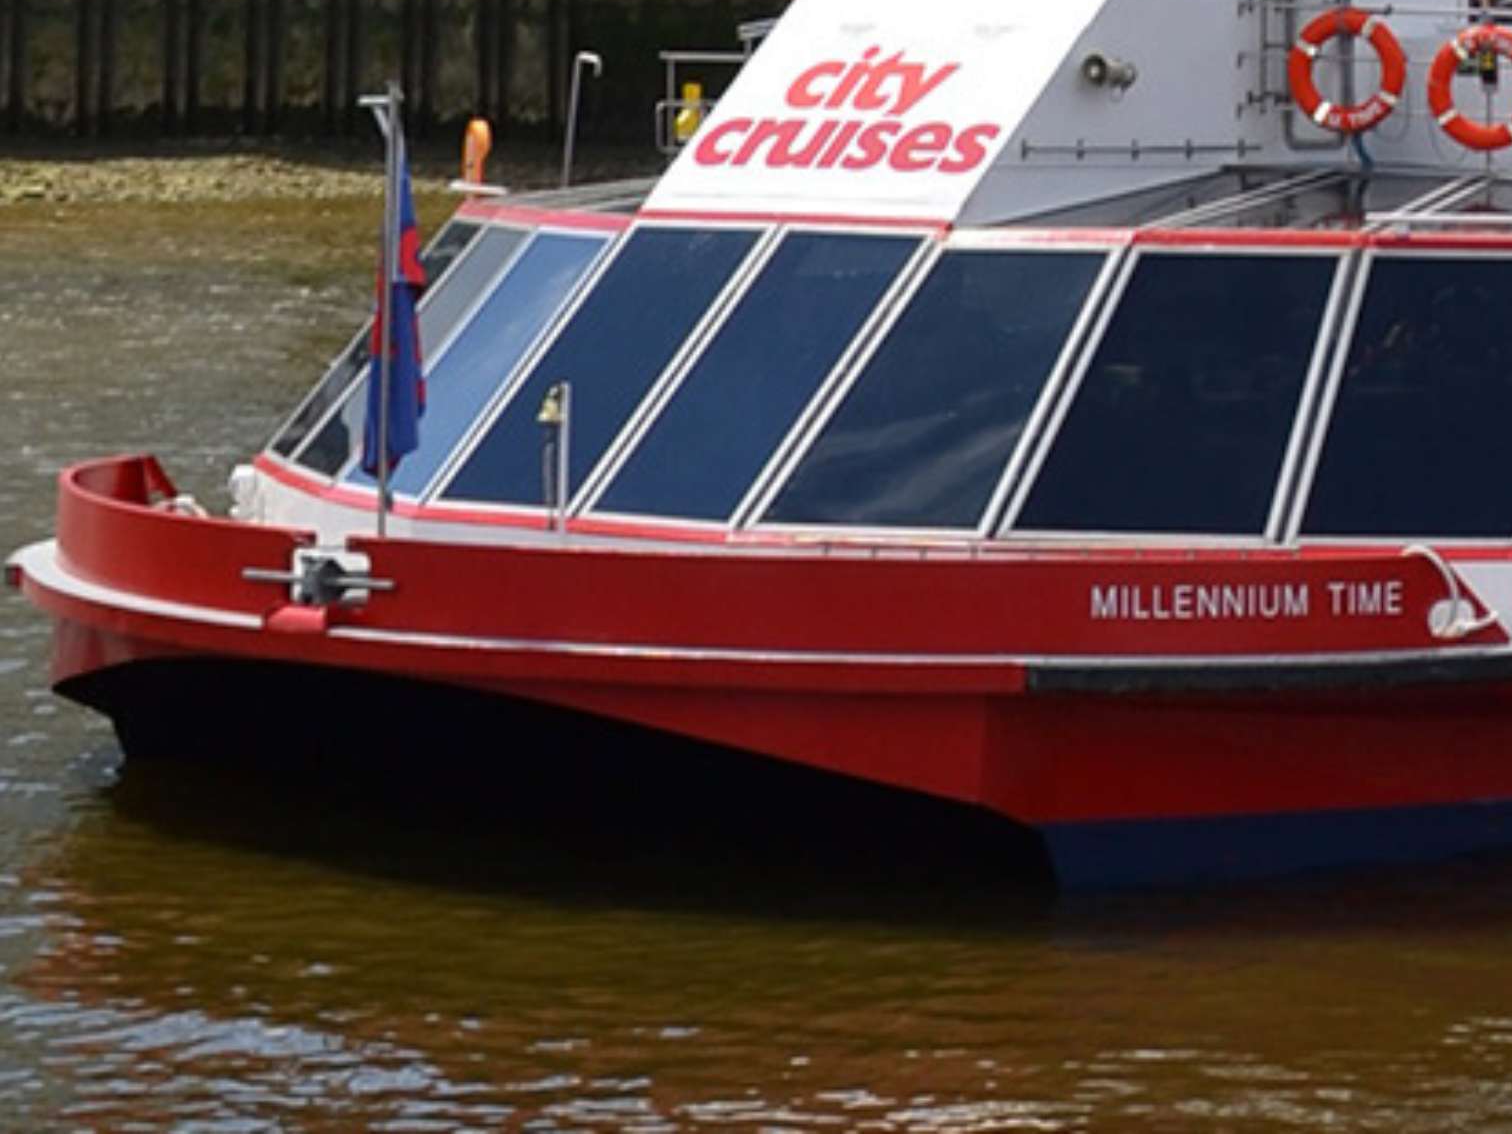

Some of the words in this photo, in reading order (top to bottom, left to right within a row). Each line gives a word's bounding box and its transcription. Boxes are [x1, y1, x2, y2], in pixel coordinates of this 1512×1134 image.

[783, 45, 961, 116] city
[694, 117, 1001, 174] cruises
[1090, 583, 1309, 620] MILLENNIUM
[1327, 580, 1403, 615] TIME
